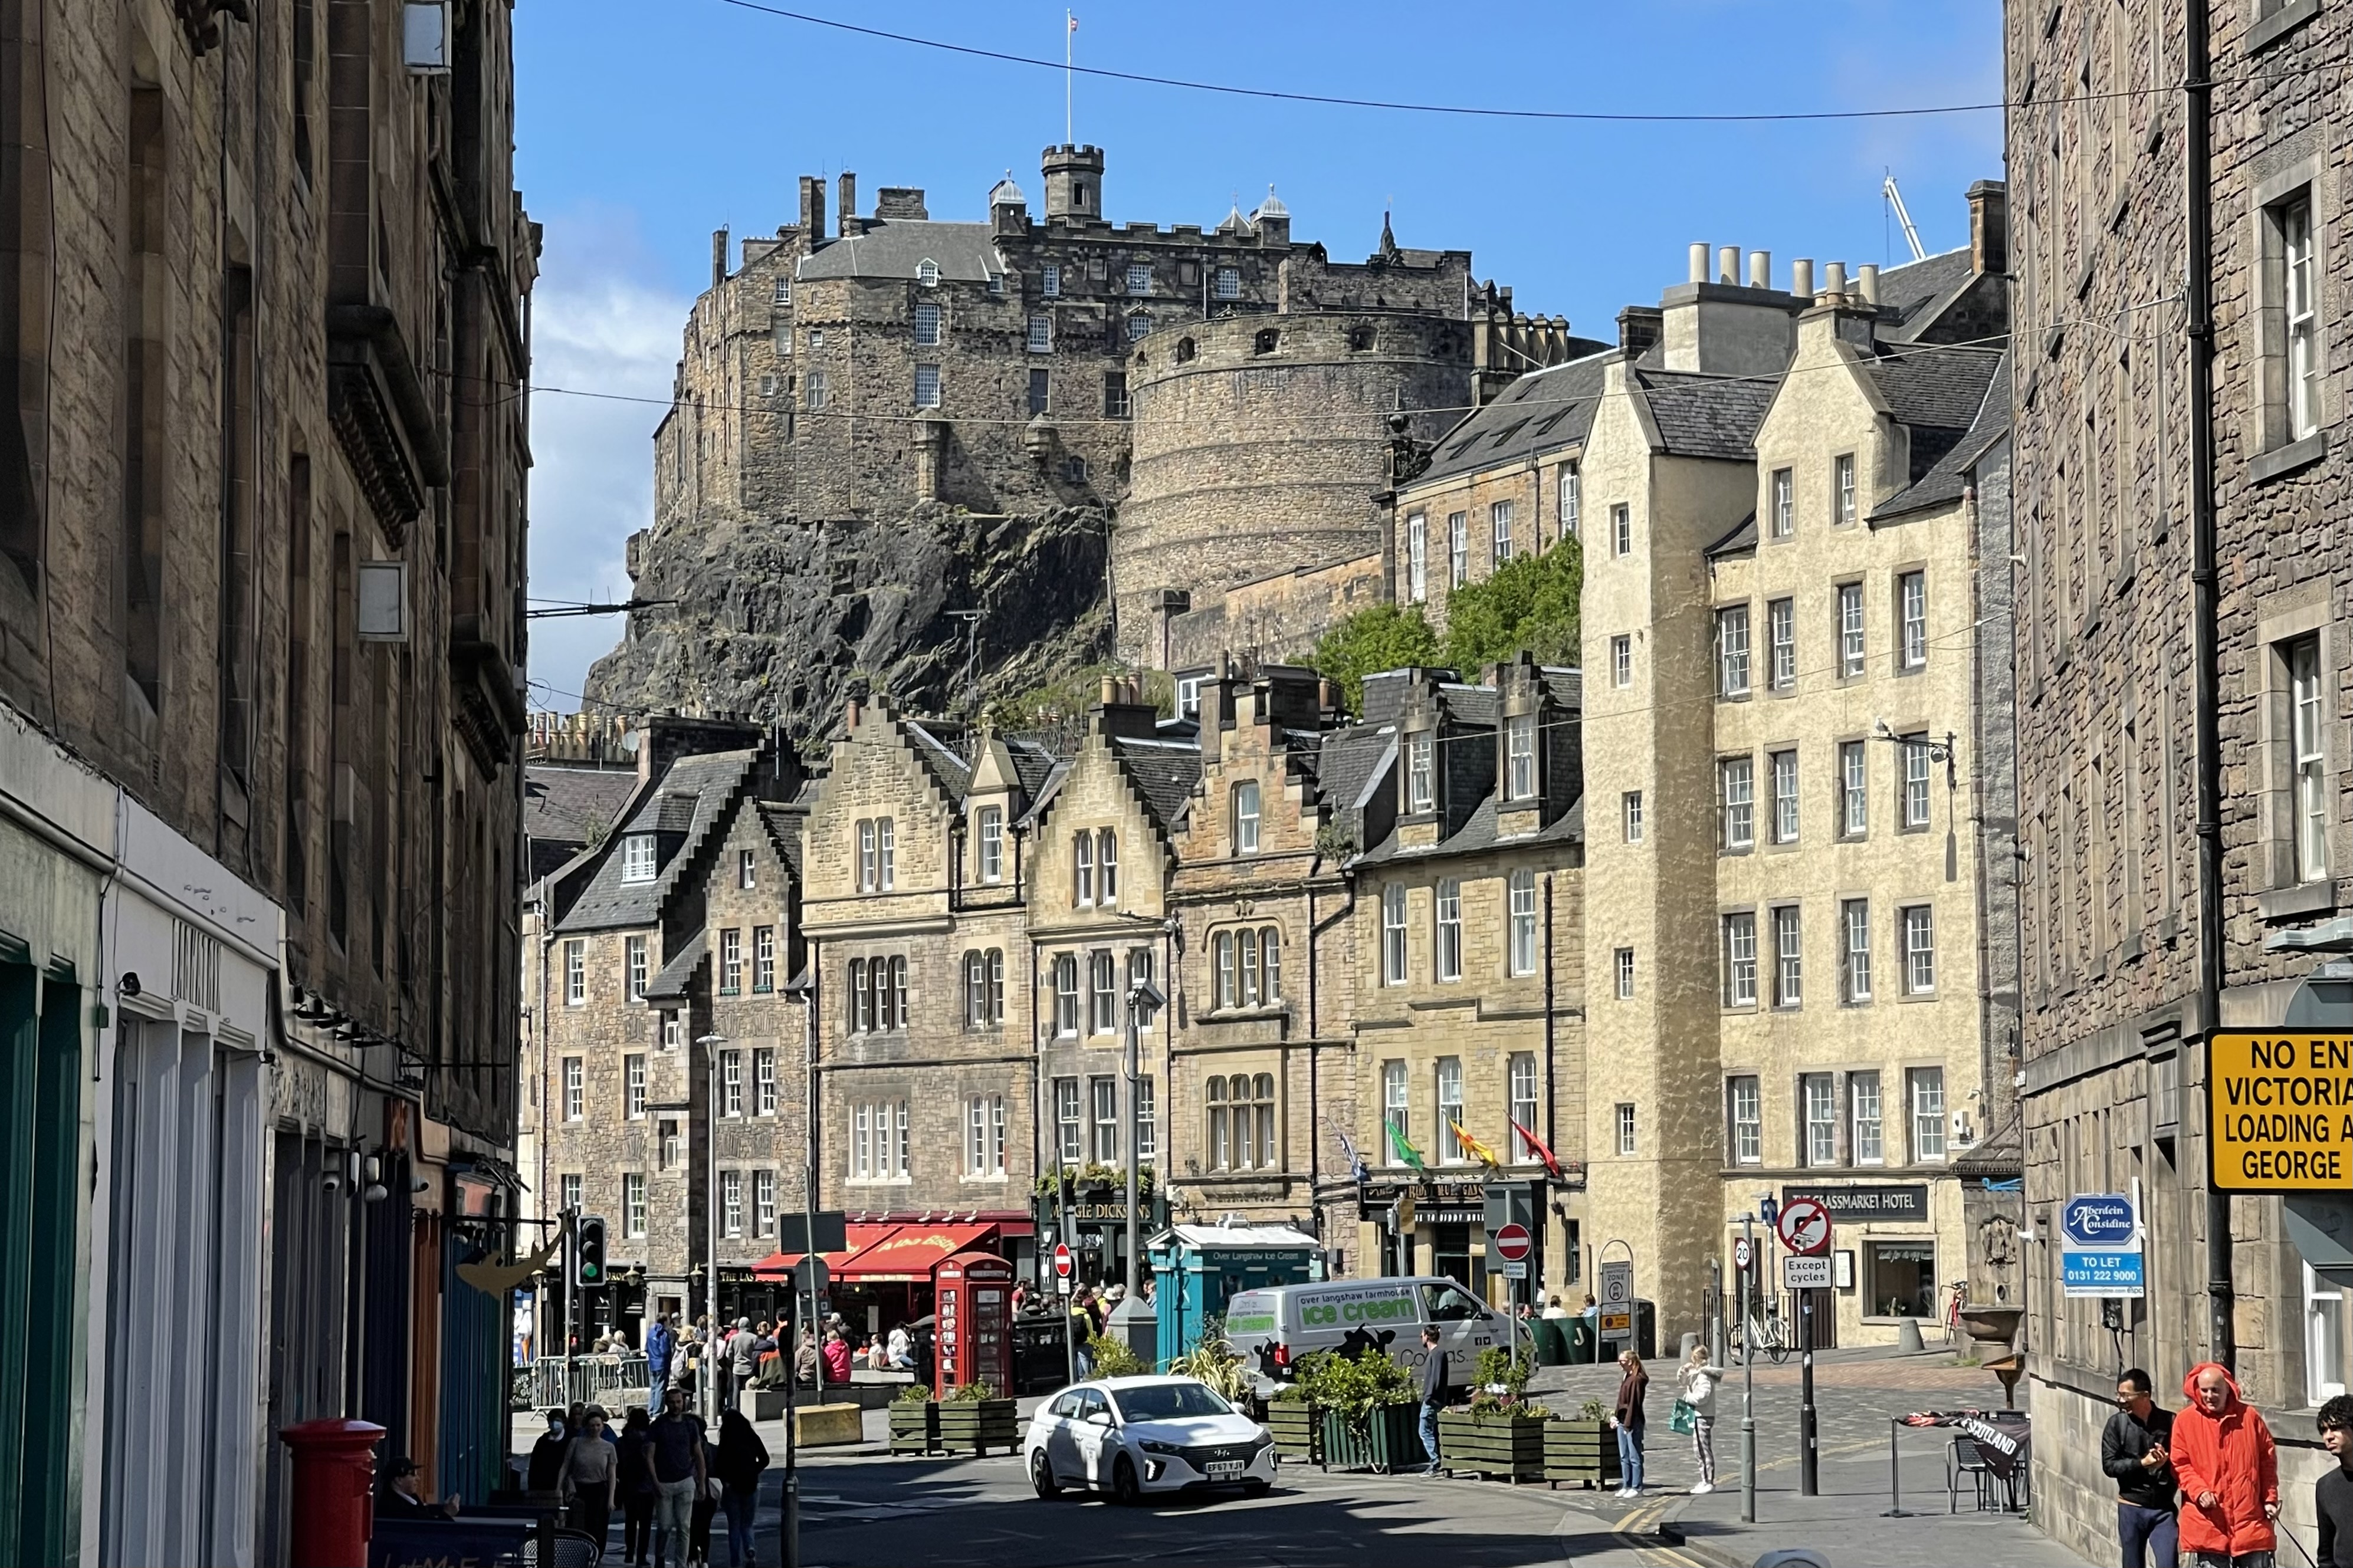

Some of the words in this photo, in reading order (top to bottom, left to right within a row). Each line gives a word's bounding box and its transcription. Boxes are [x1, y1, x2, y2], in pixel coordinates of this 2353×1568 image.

[2251, 1040, 2296, 1069] NO
[2310, 1040, 2353, 1069] EN
[2225, 1077, 2353, 1106] VICTORIA
[2225, 1113, 2329, 1143] LOADING
[2242, 1150, 2342, 1179] GEORGE
[1882, 1194, 1915, 1208] HOTEL
[1051, 1204, 1091, 1218] MGIE
[1095, 1204, 1150, 1218] DICKSN'S
[2070, 1205, 2124, 1227] Aberdein
[2083, 1215, 2132, 1234] Considine
[1213, 1252, 1231, 1260] Over
[1232, 1252, 1264, 1262] Langshaw
[1265, 1252, 1276, 1260] Ice
[1277, 1251, 1299, 1260] Cream
[1737, 1247, 1748, 1260] 20
[1788, 1260, 1826, 1271] Except
[2082, 1257, 2098, 1267] TO
[2101, 1257, 2122, 1267] LET
[720, 1271, 737, 1282] THE
[740, 1271, 754, 1282] LAS
[1790, 1272, 1826, 1282] cycles
[2068, 1270, 2091, 1281] 0131
[2094, 1270, 2111, 1281] 222
[2114, 1270, 2137, 1281] 9000
[1300, 1296, 1320, 1304] over
[1322, 1292, 1362, 1305] langshaw
[1365, 1288, 1410, 1299] farmhouse
[1343, 1298, 1415, 1322] cream
[1967, 1418, 2017, 1456] SCOTLAND
